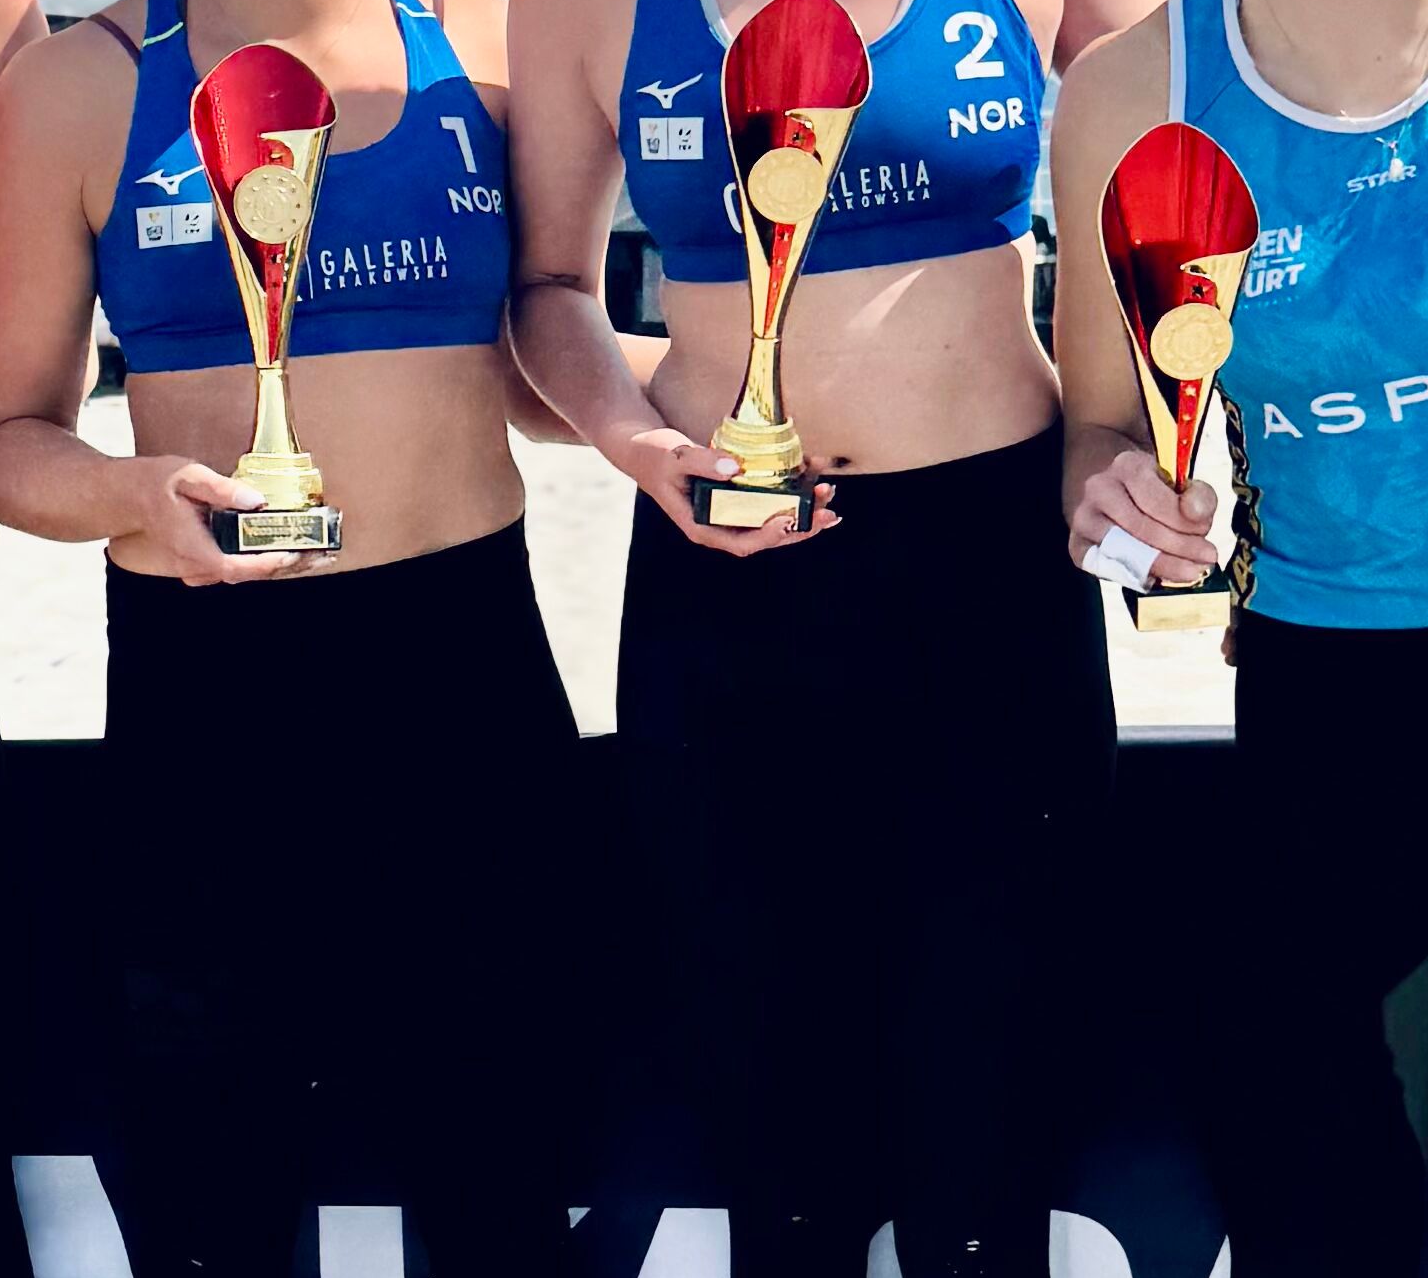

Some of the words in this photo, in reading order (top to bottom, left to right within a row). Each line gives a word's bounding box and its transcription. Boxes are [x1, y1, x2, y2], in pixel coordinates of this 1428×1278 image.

[944, 11, 1005, 80] 2
[948, 97, 1026, 139] NOR
[440, 116, 477, 174] 1
[828, 159, 930, 199] LERIA
[447, 186, 503, 215] NOR
[831, 187, 930, 213] AKOWSKA
[320, 235, 447, 276] GALERIA
[324, 264, 448, 290] KRAKOWSKA
